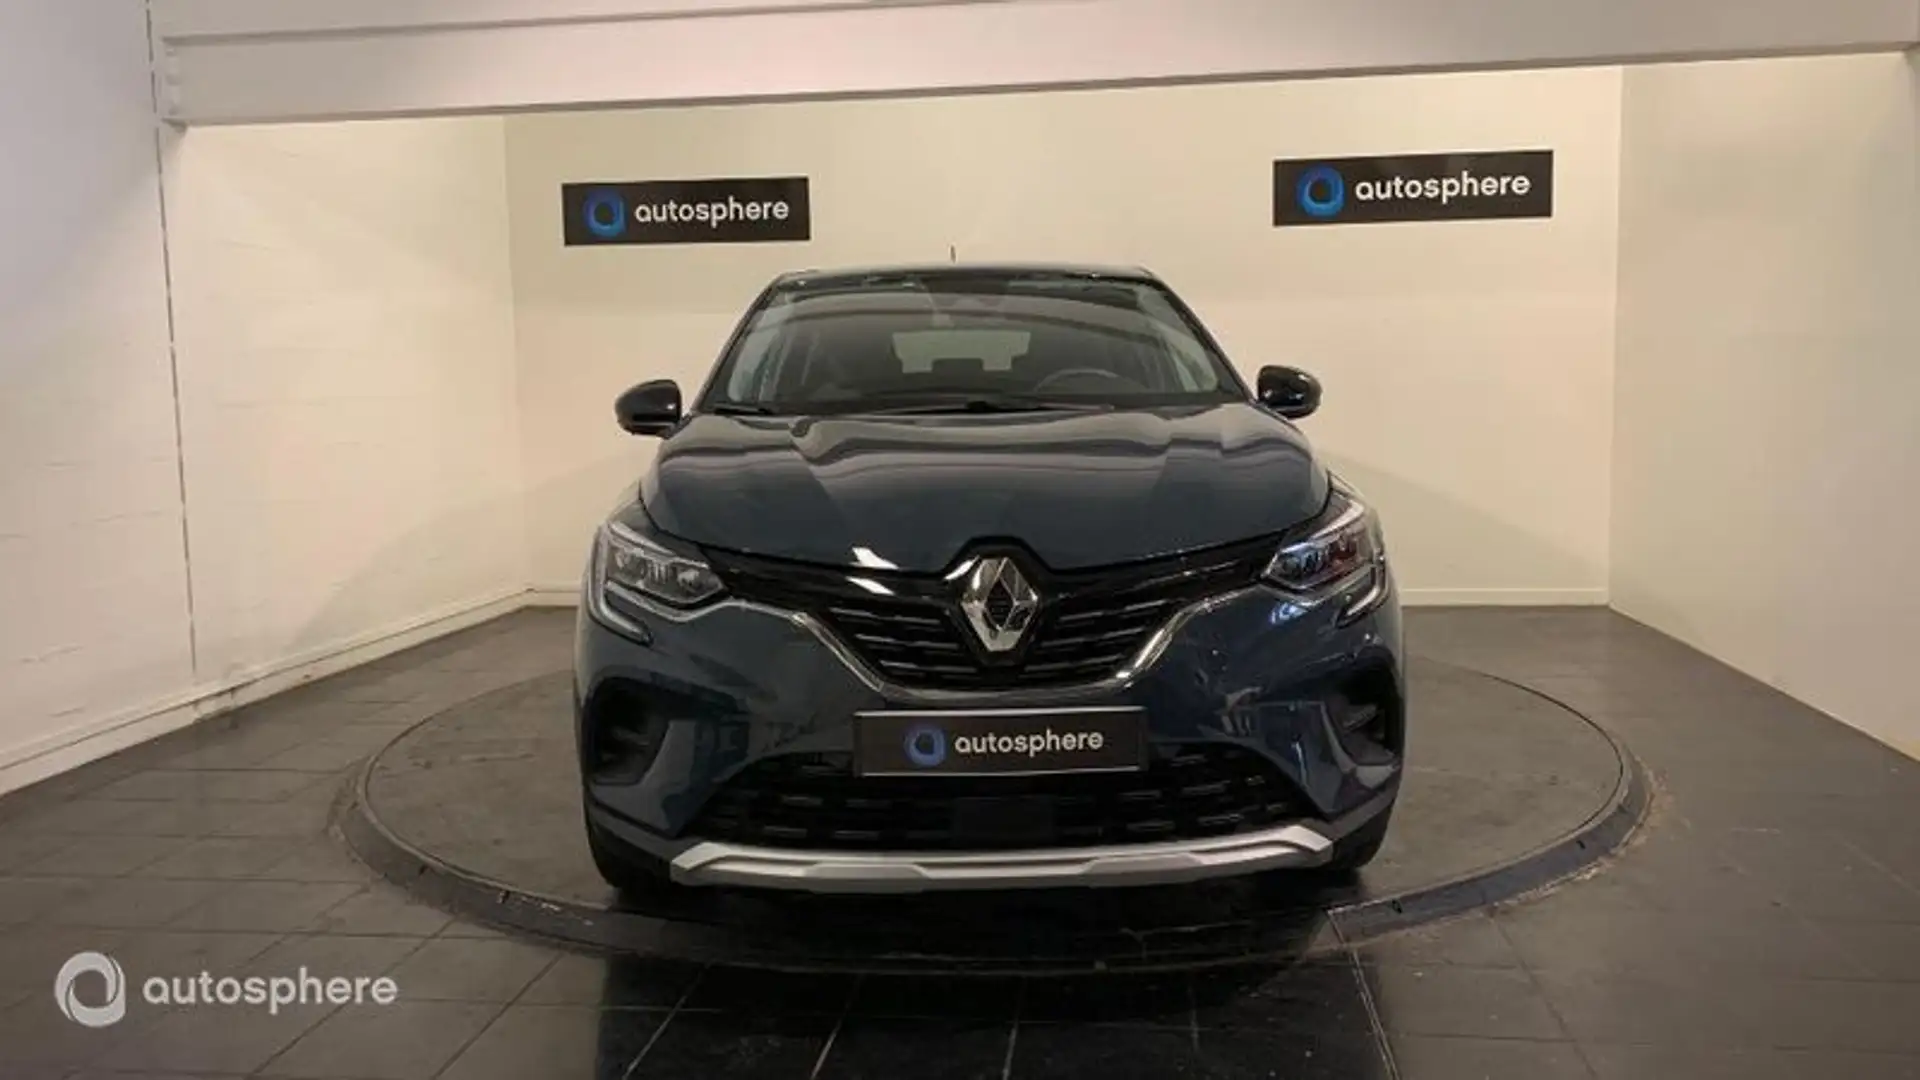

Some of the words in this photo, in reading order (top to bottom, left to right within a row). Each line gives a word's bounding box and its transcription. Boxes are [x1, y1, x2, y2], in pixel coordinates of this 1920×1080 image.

[1355, 171, 1531, 205] autosphere
[634, 195, 790, 229] autosphere
[954, 729, 1104, 758] autosphere
